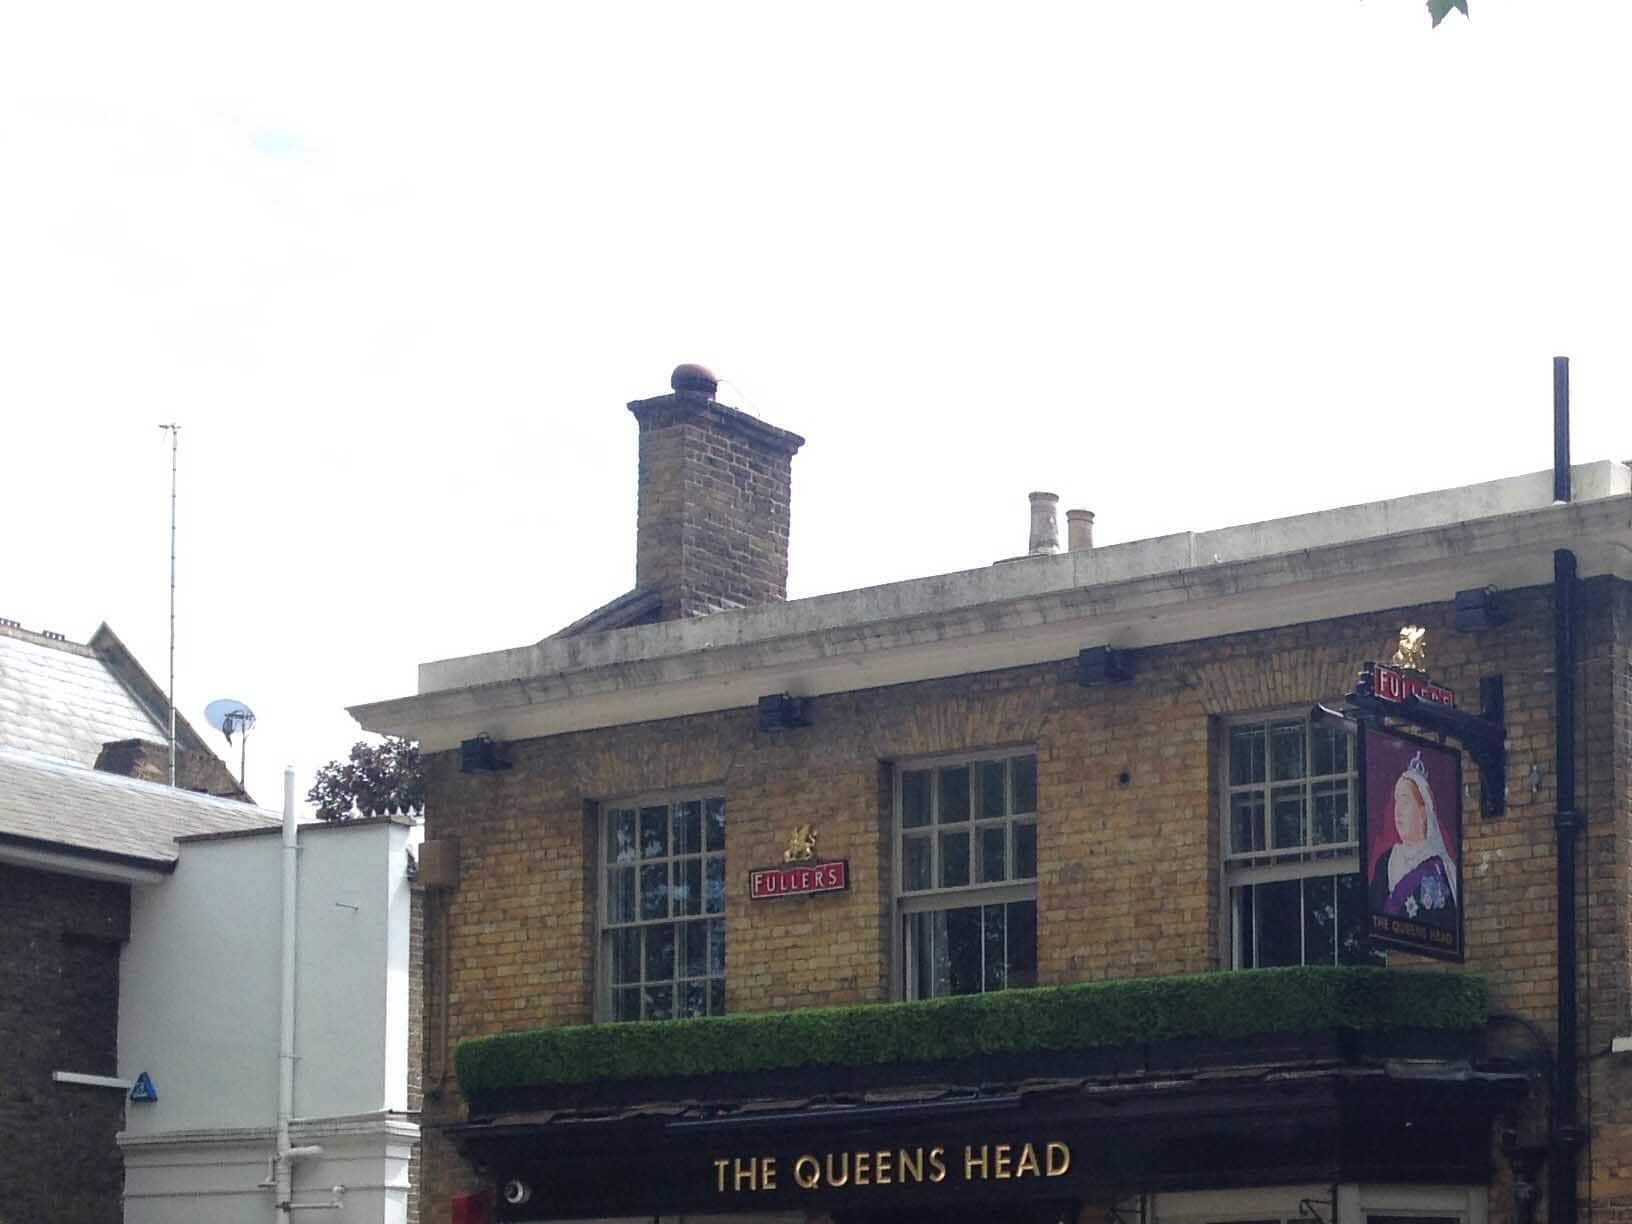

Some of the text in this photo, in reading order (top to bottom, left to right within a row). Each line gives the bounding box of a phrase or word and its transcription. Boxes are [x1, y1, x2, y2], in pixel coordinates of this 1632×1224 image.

[754, 868, 838, 893] FULLERS
[714, 1141, 1072, 1192] THE QUEENS HEAD
